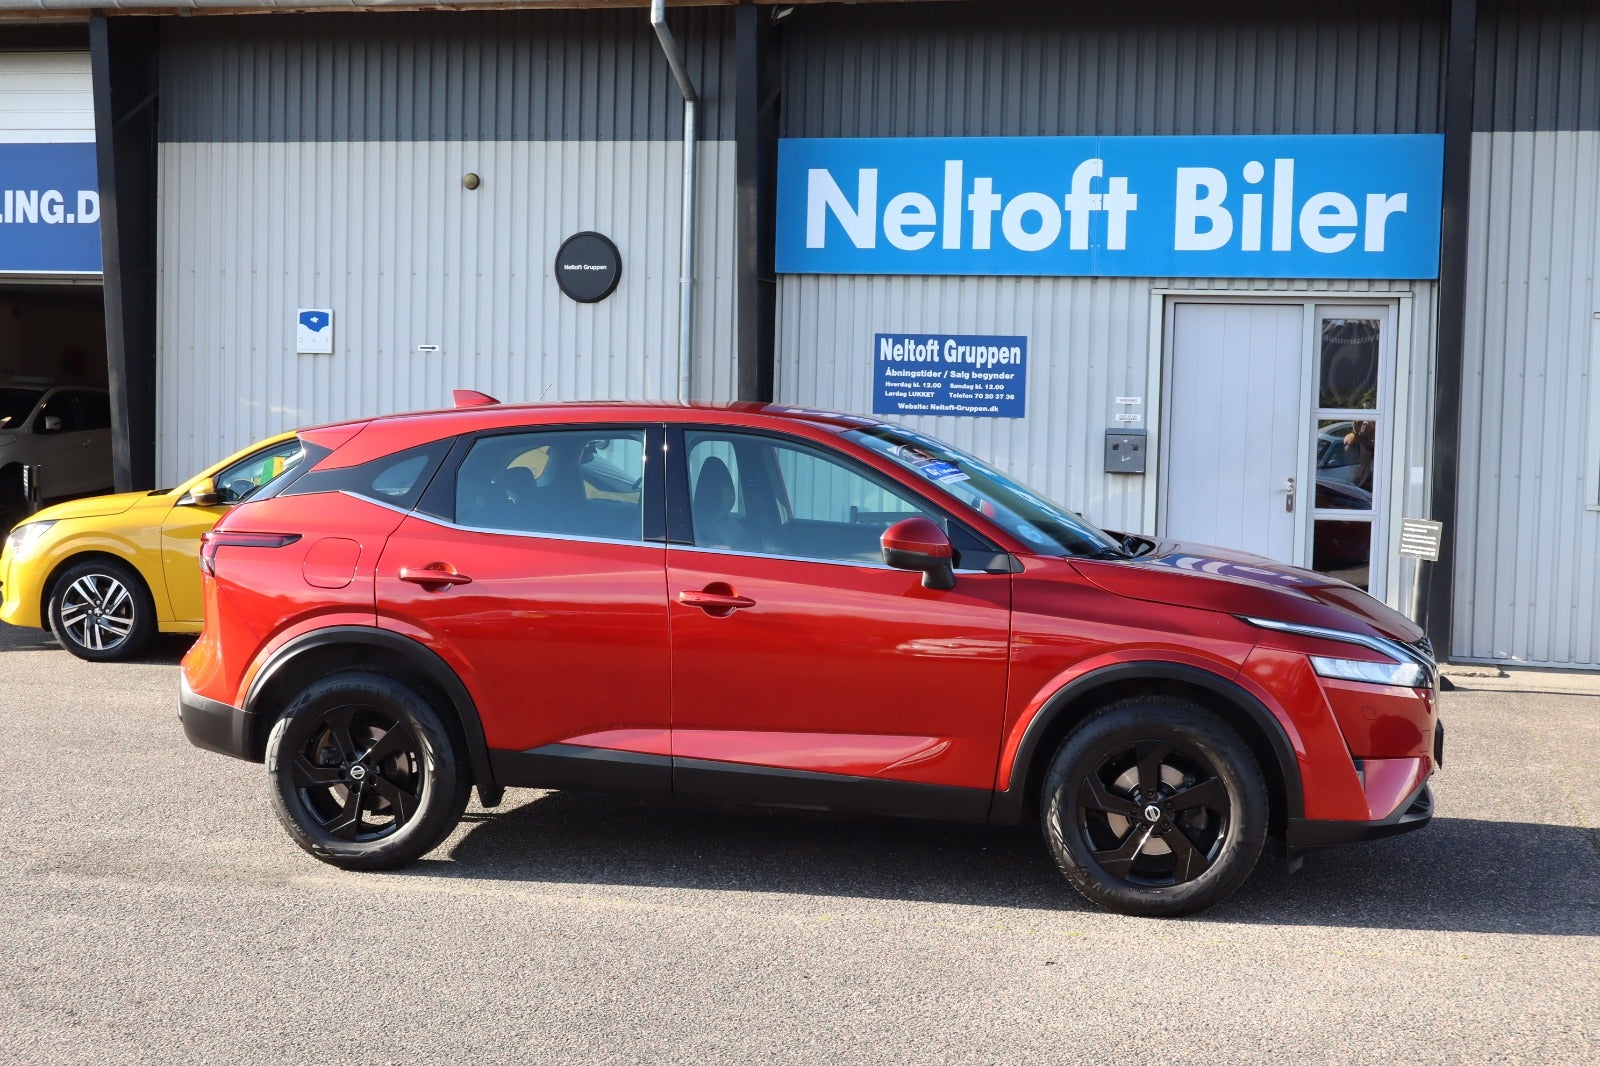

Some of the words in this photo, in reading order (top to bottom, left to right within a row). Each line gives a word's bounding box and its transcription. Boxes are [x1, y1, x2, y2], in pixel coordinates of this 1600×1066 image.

[0, 190, 100, 224] ING.D
[806, 158, 1137, 252] Neltoft
[1174, 158, 1408, 254] Biler
[880, 338, 939, 362] Neltoft
[944, 339, 1021, 368] Gruppen
[885, 367, 942, 378] Åbningstider
[950, 370, 970, 380] Salg
[971, 371, 1015, 380] begynder
[885, 381, 912, 389] Hverdag
[897, 402, 929, 410] Website:
[930, 403, 999, 412] Neltoft-Gruppen.dk
